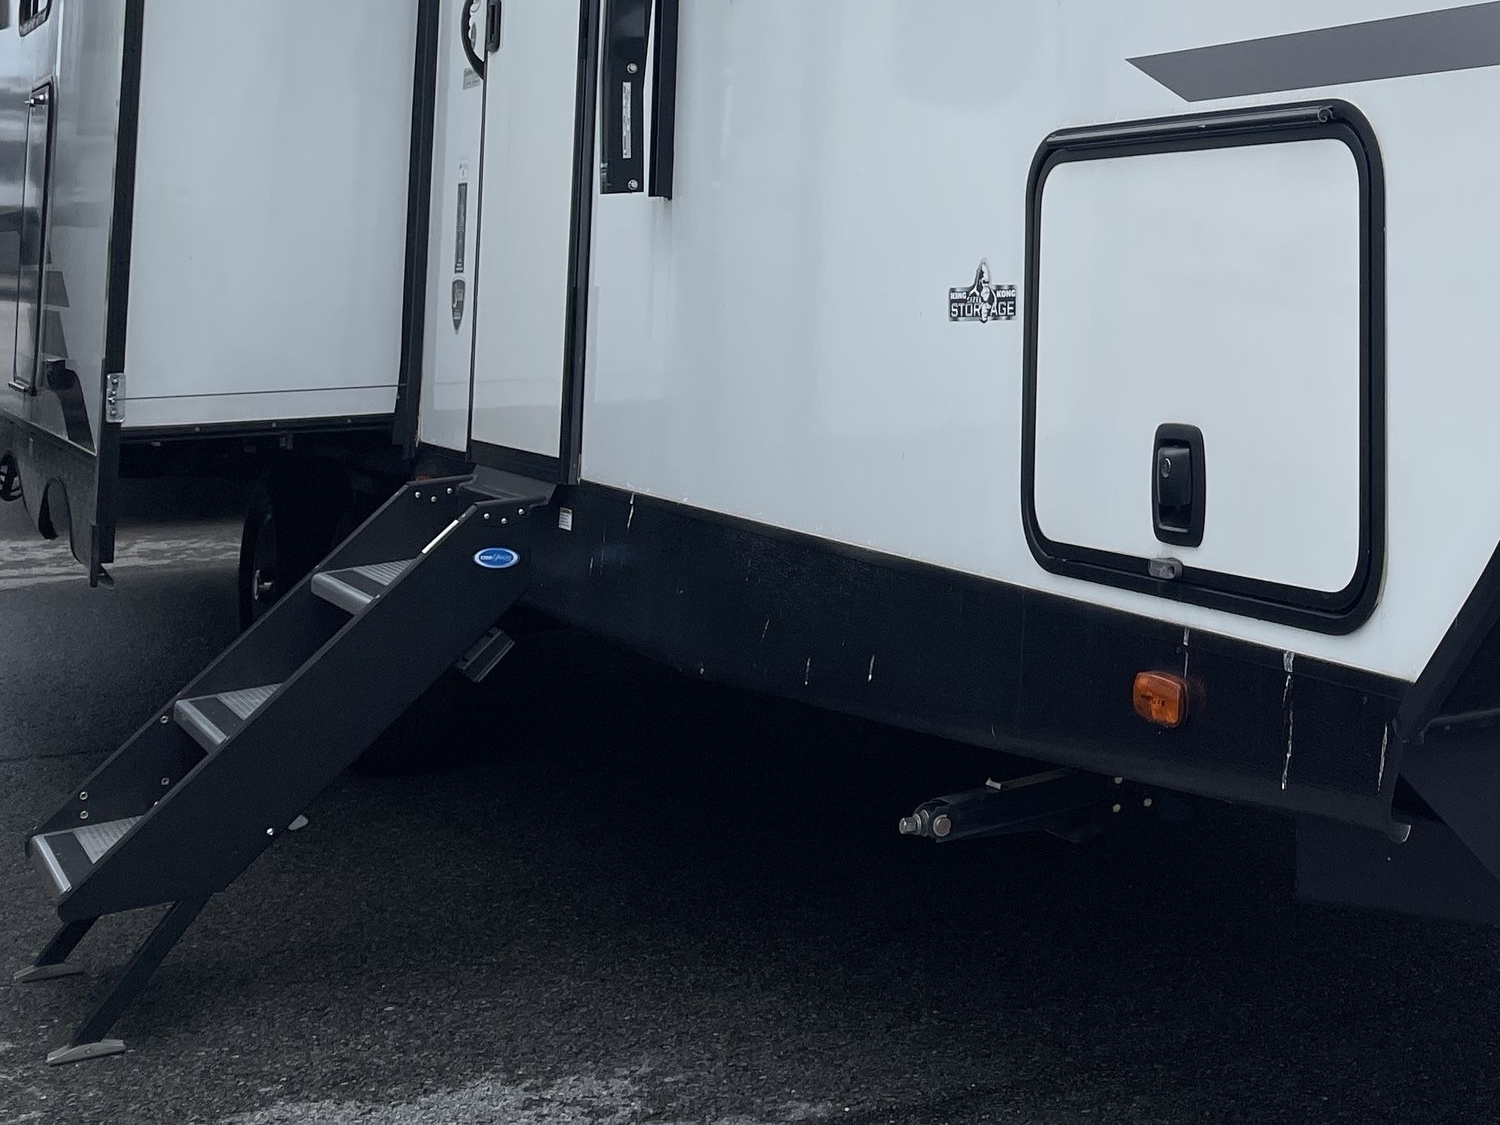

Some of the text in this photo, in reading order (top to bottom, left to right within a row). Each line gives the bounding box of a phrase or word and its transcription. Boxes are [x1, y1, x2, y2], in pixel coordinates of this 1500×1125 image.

[950, 289, 1016, 300] KING KONG
[951, 302, 1014, 317] STORAGE
